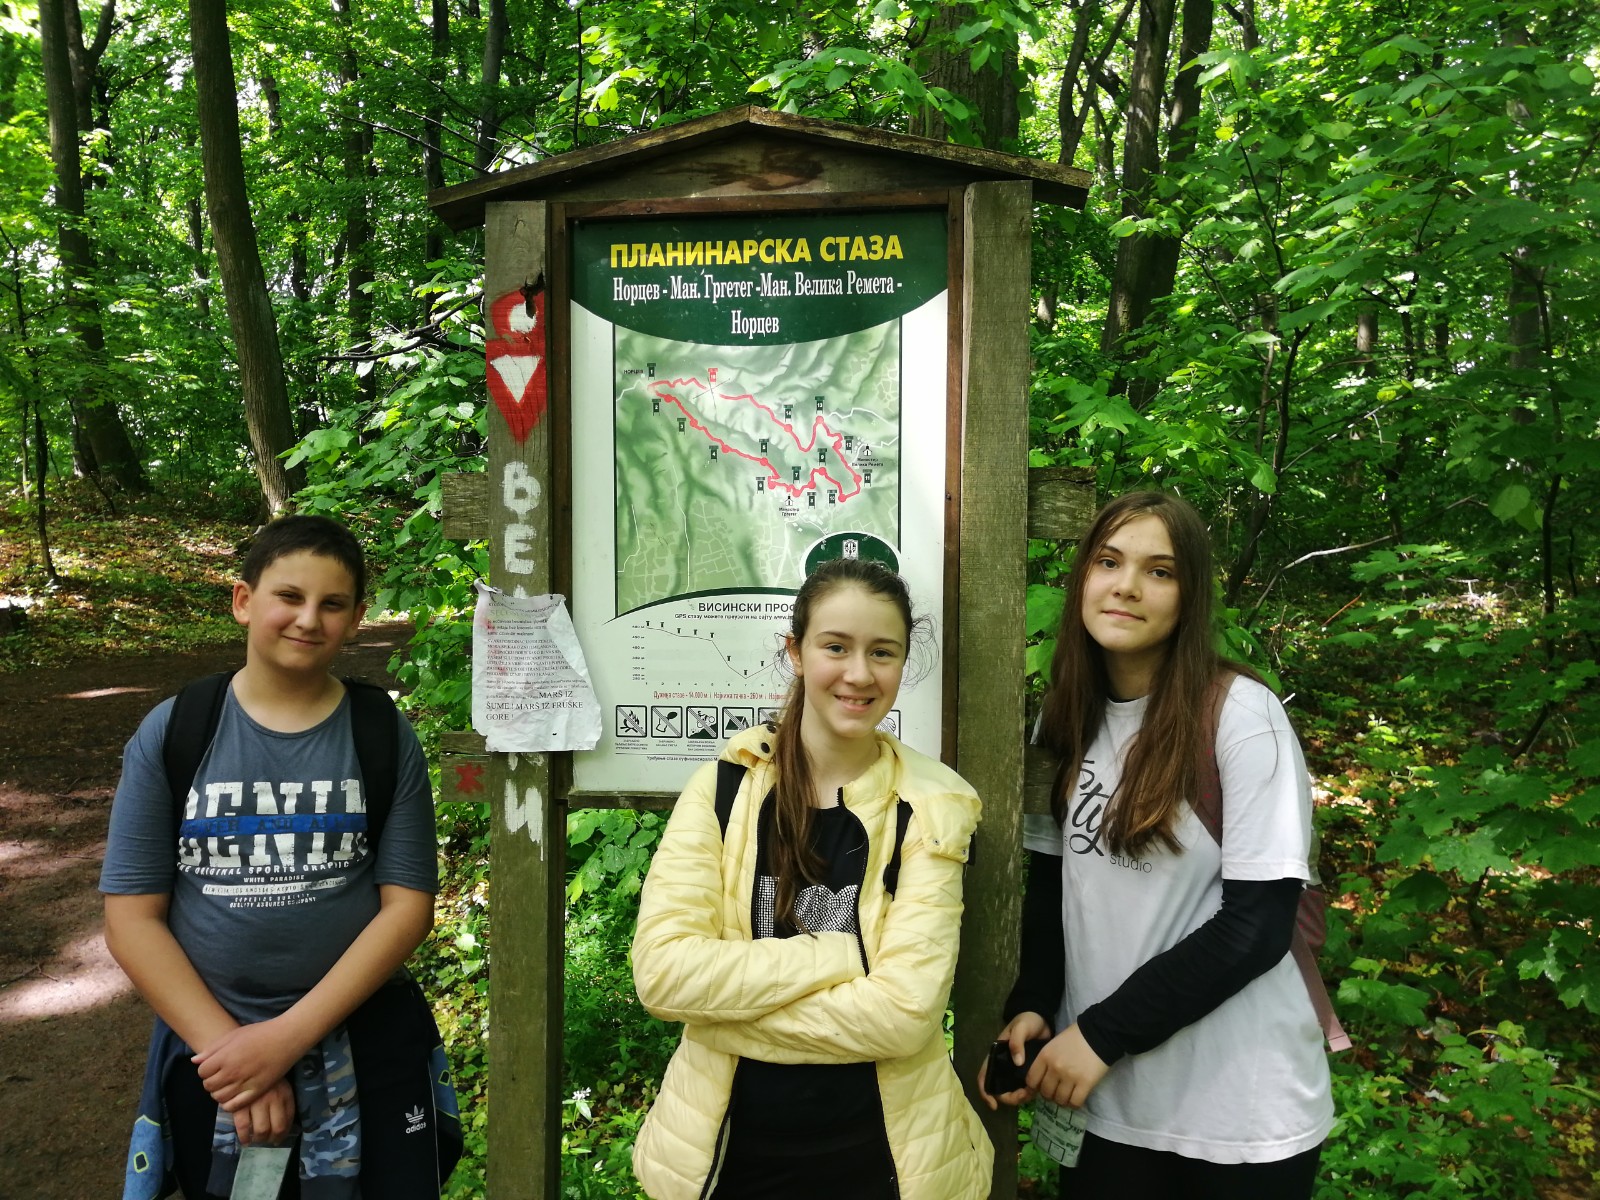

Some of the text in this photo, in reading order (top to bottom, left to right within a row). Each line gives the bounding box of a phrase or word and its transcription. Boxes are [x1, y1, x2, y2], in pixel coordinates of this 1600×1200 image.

[610, 234, 904, 268] ПЛАНИНАРСКА СТАЗА
[613, 277, 660, 306] Норцев
[670, 275, 700, 299] Ман.
[794, 271, 843, 296] Велика
[846, 270, 895, 295] Ремета
[731, 310, 779, 338] Норцев
[698, 602, 761, 612] ВИСИНСКИ
[539, 690, 563, 699] MARŠ
[565, 690, 573, 698] IZ
[515, 702, 540, 710] MARŠ
[552, 701, 583, 709] FRUŠKE
[1109, 853, 1153, 873] studio
[194, 866, 241, 876] ORIGINAL
[248, 864, 296, 874] SPORTS
[269, 874, 305, 882] PARADISE
